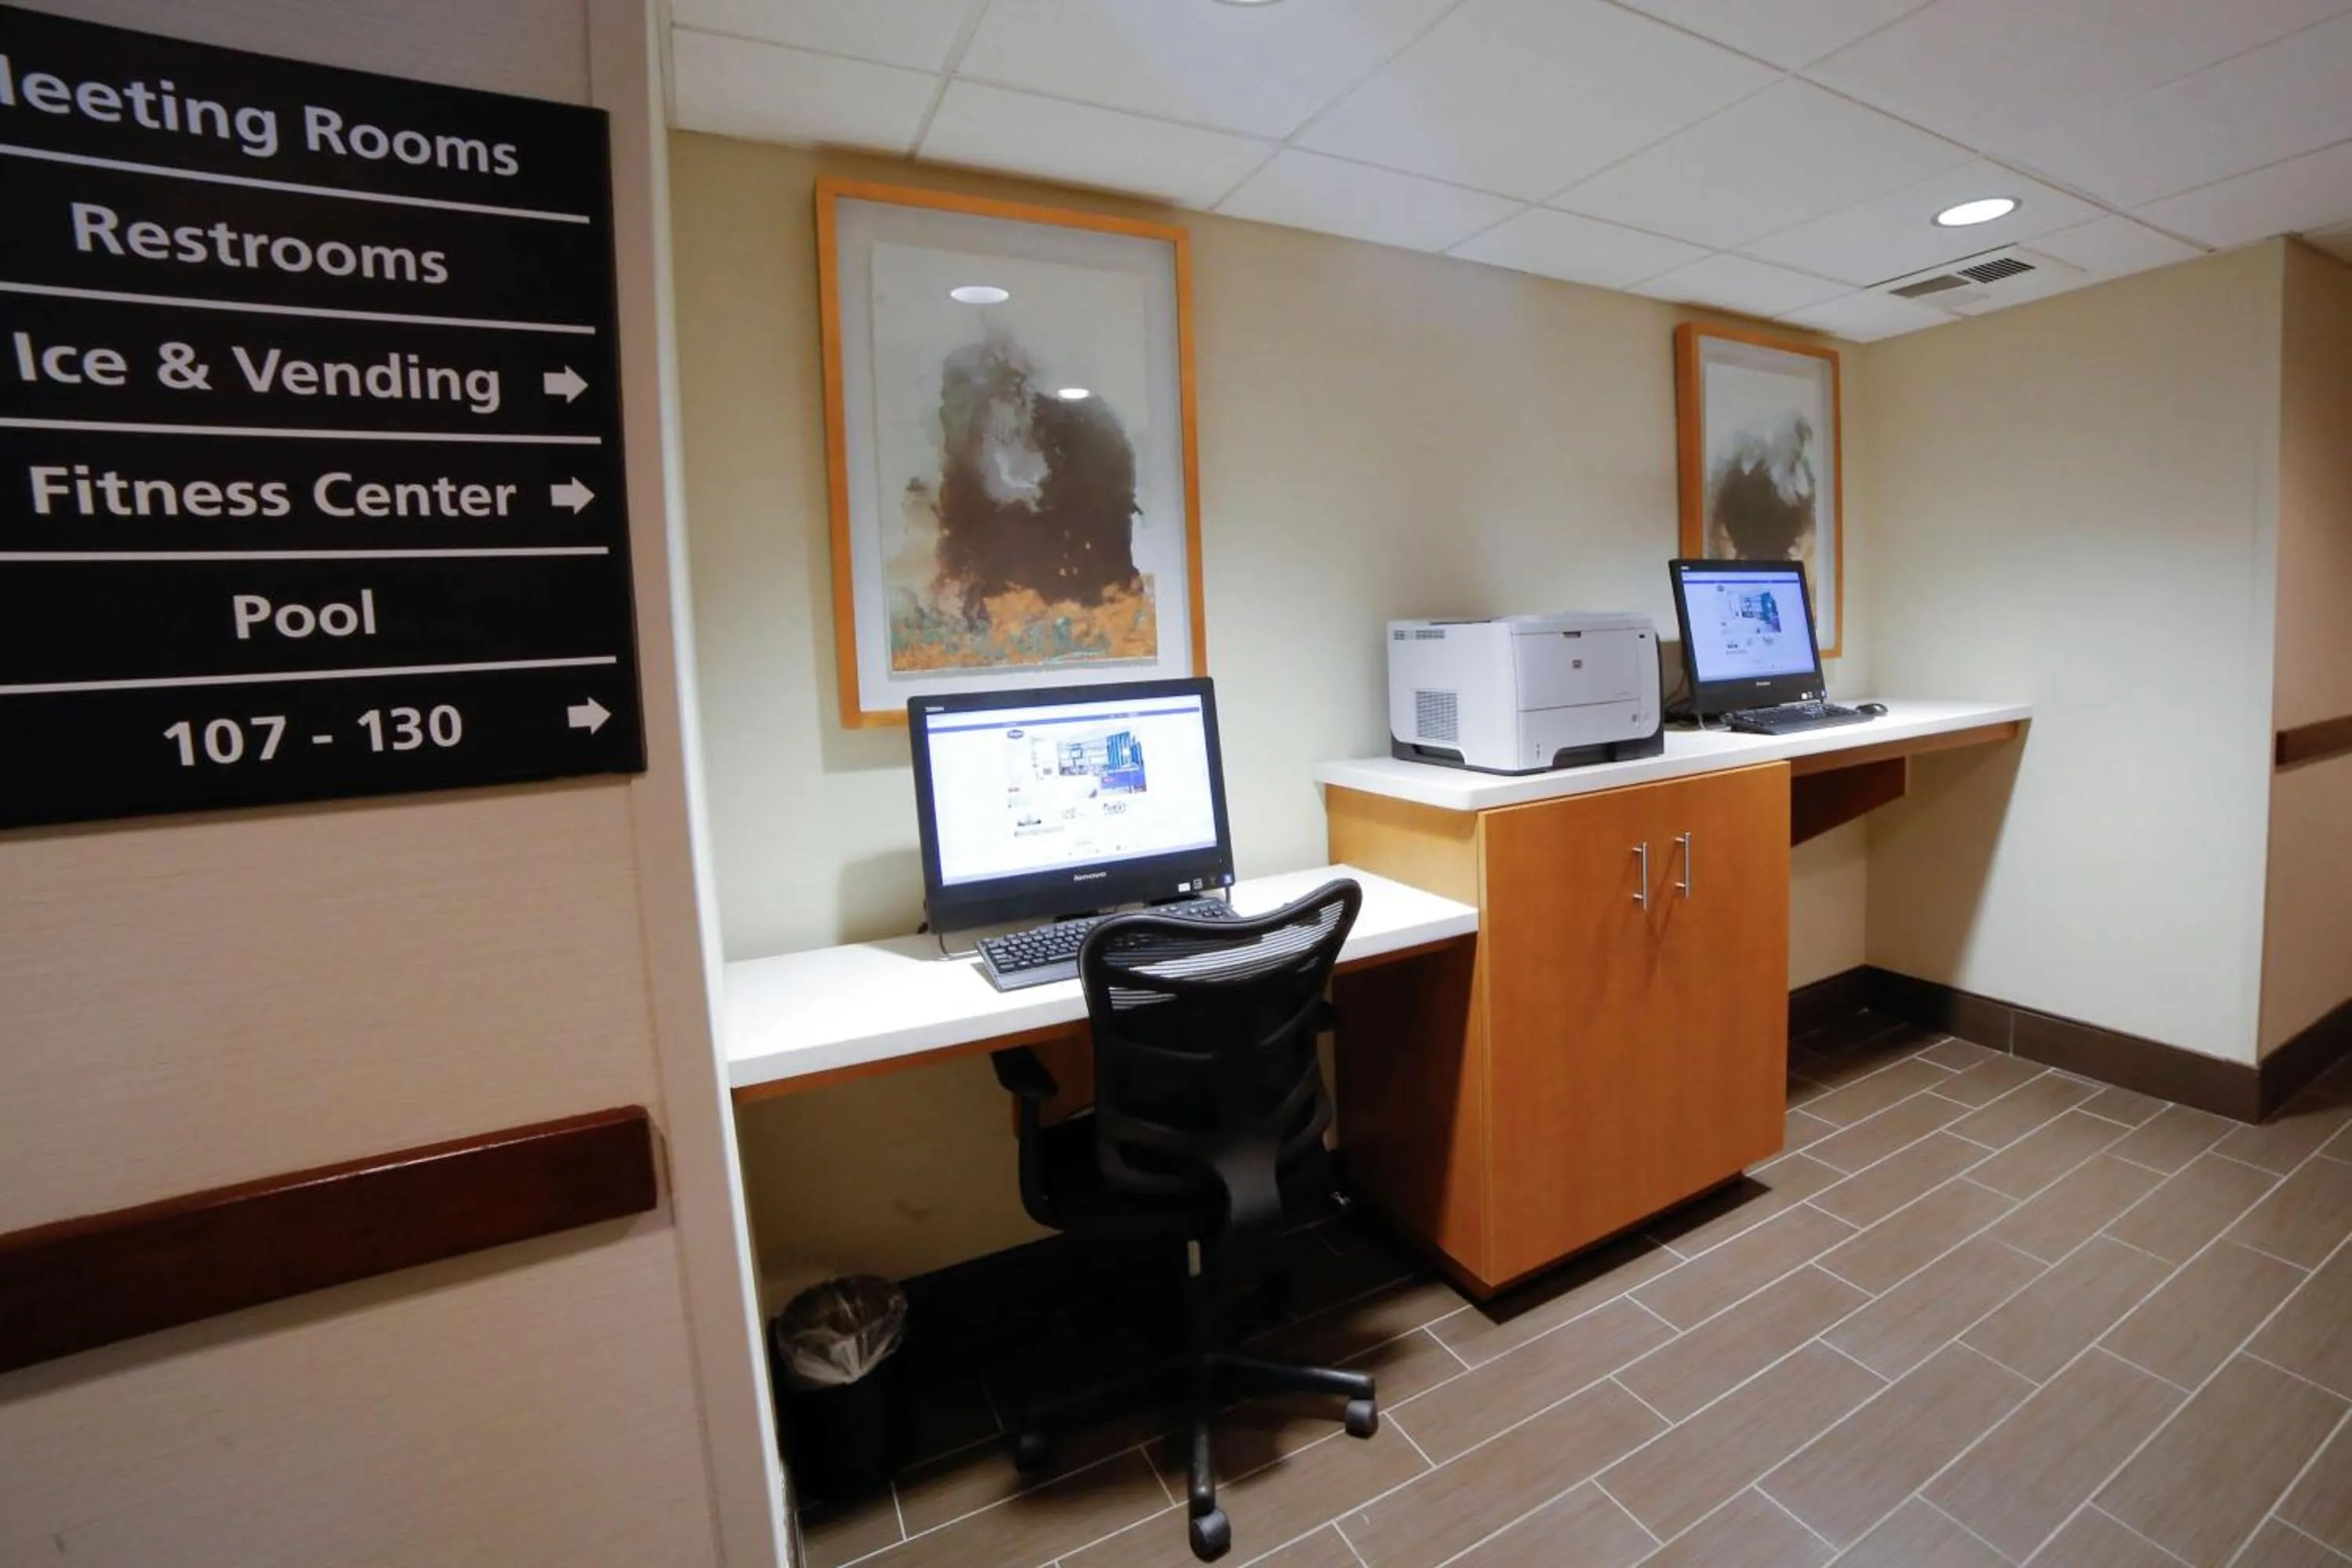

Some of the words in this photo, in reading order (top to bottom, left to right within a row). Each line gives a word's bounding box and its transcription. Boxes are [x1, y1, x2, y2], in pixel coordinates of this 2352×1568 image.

[0, 54, 278, 158] eeting
[304, 106, 518, 176] Rooms
[72, 202, 448, 284] Restrooms
[13, 332, 127, 386] Ice
[158, 342, 212, 390] &
[232, 346, 500, 414] Vending
[30, 465, 291, 517] Fitness
[314, 472, 517, 517] Center
[233, 589, 376, 639] Pool
[163, 715, 287, 766] 107
[312, 734, 333, 744] -
[358, 705, 463, 752] 130
